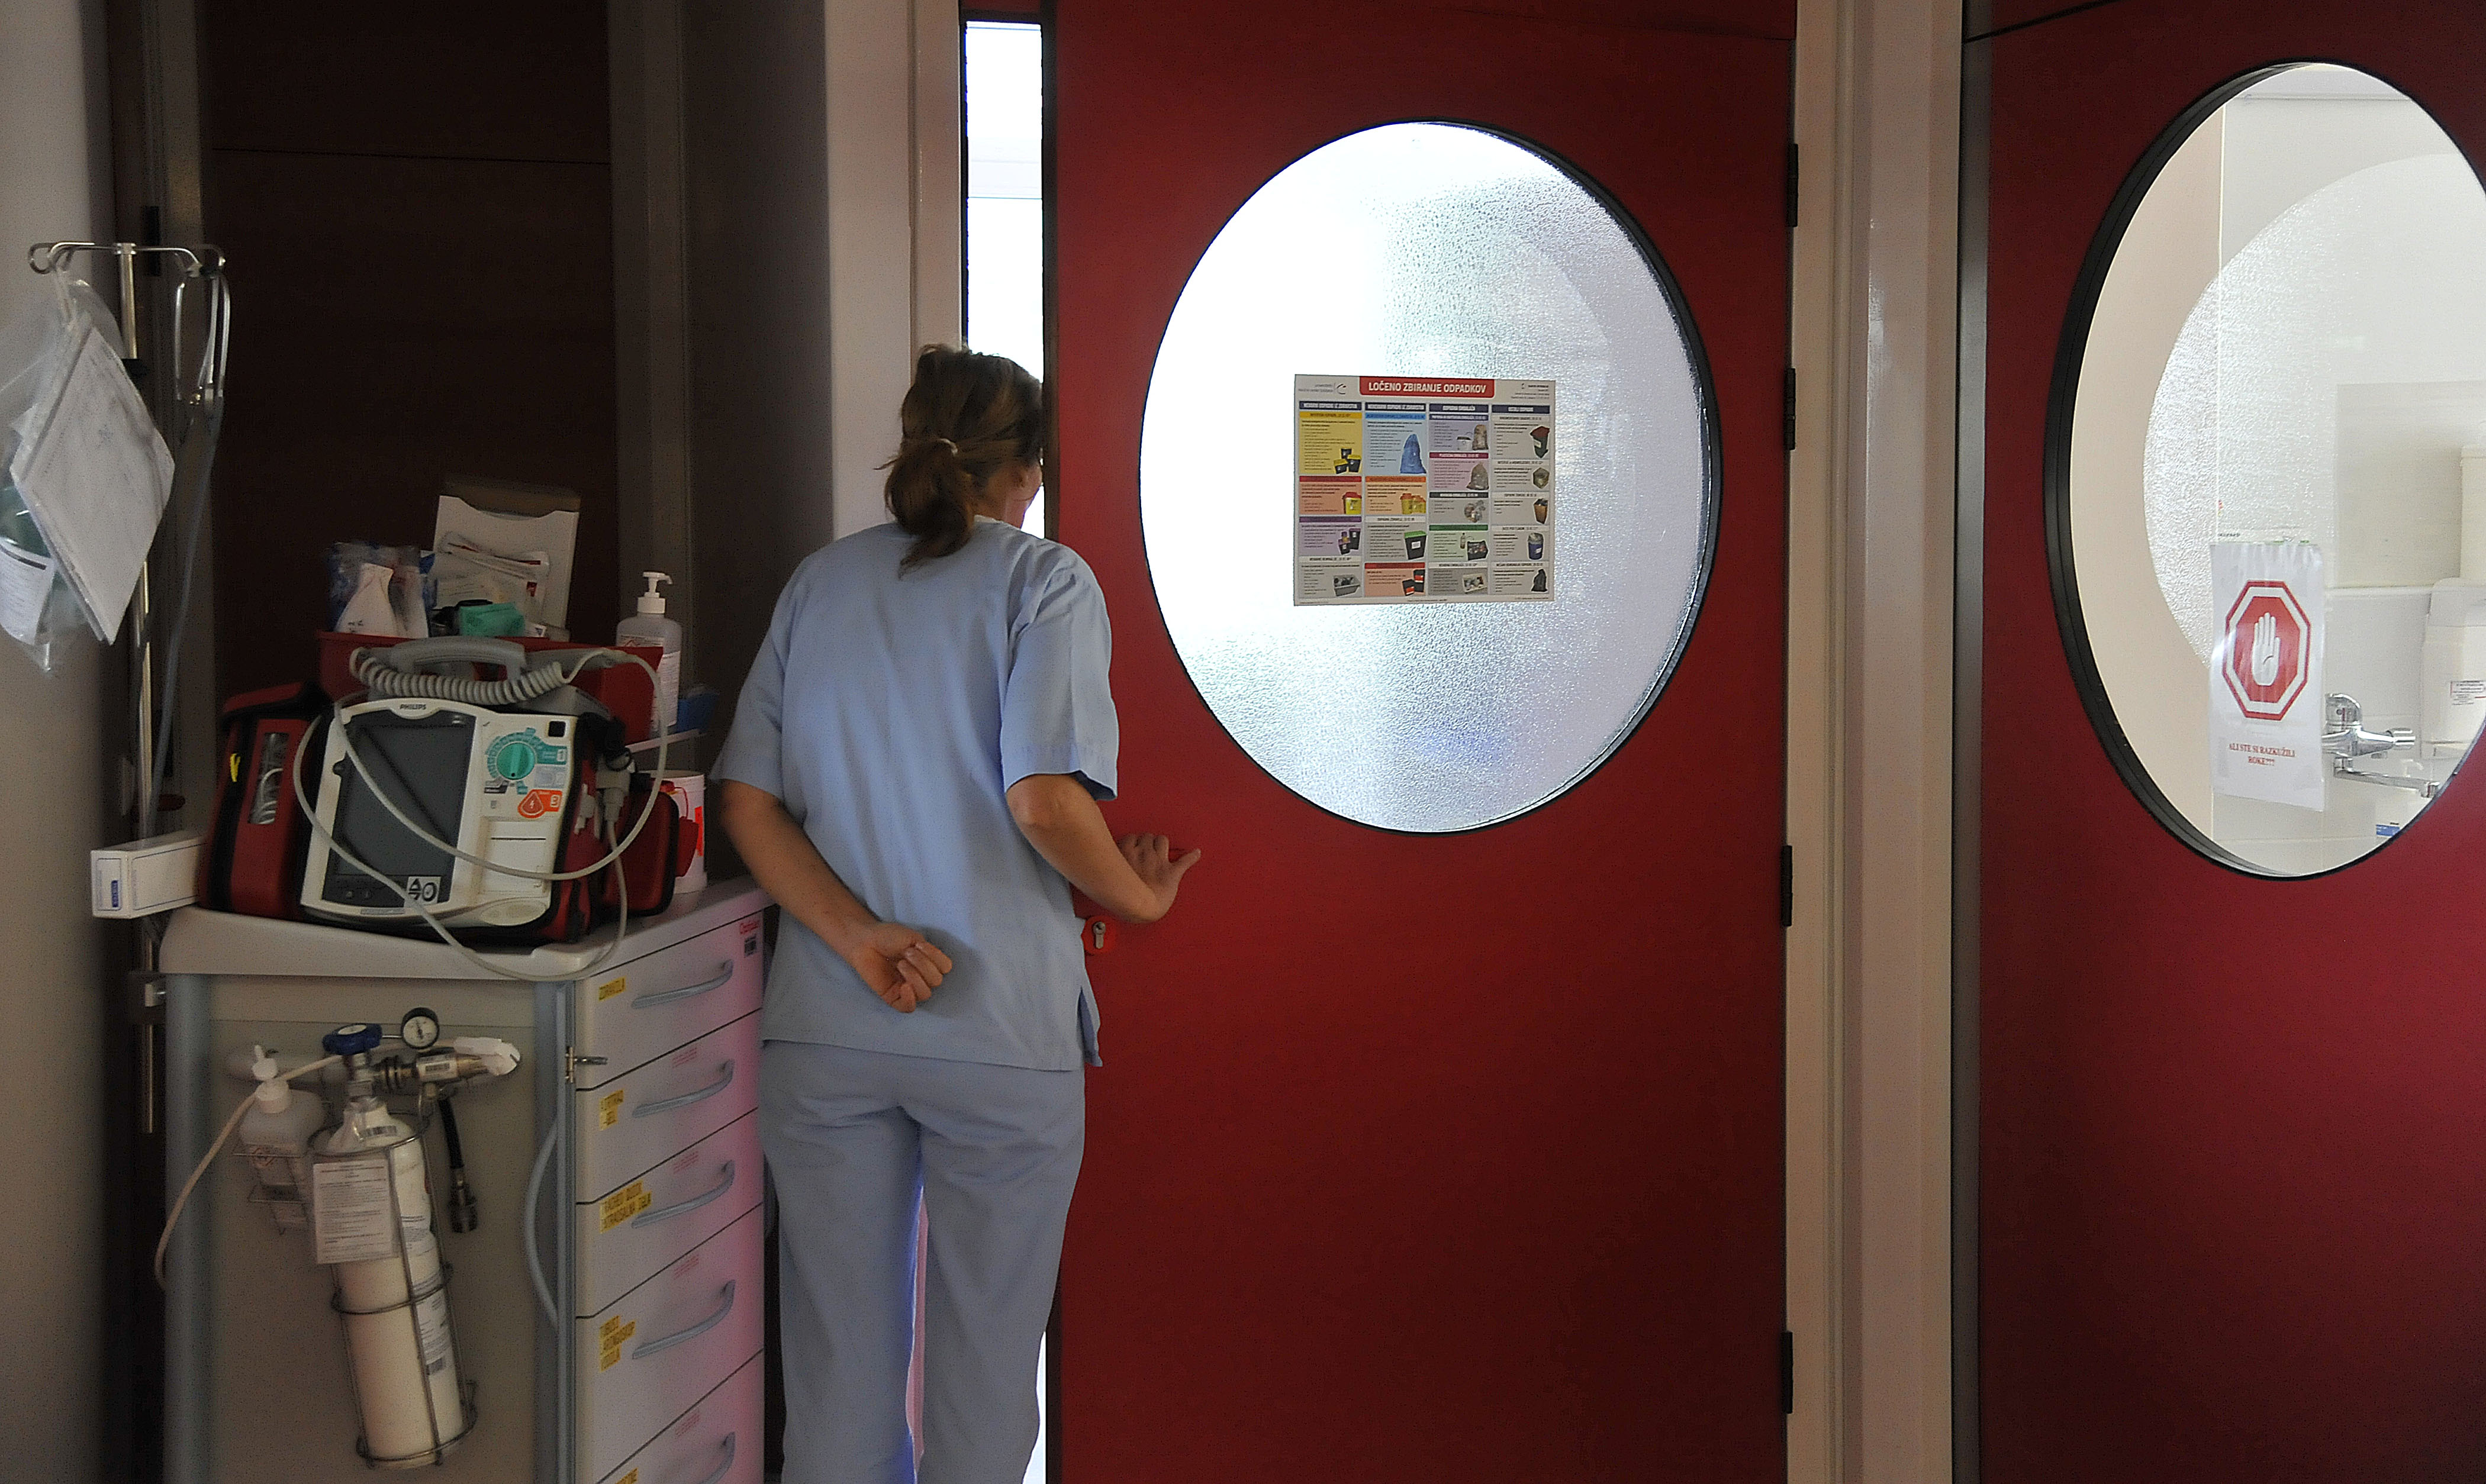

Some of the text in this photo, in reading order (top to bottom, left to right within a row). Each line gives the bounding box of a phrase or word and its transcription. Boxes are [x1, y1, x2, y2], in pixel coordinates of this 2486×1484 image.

[1368, 380, 1486, 393] LOČENO ZBIRANJE ODPADKOV
